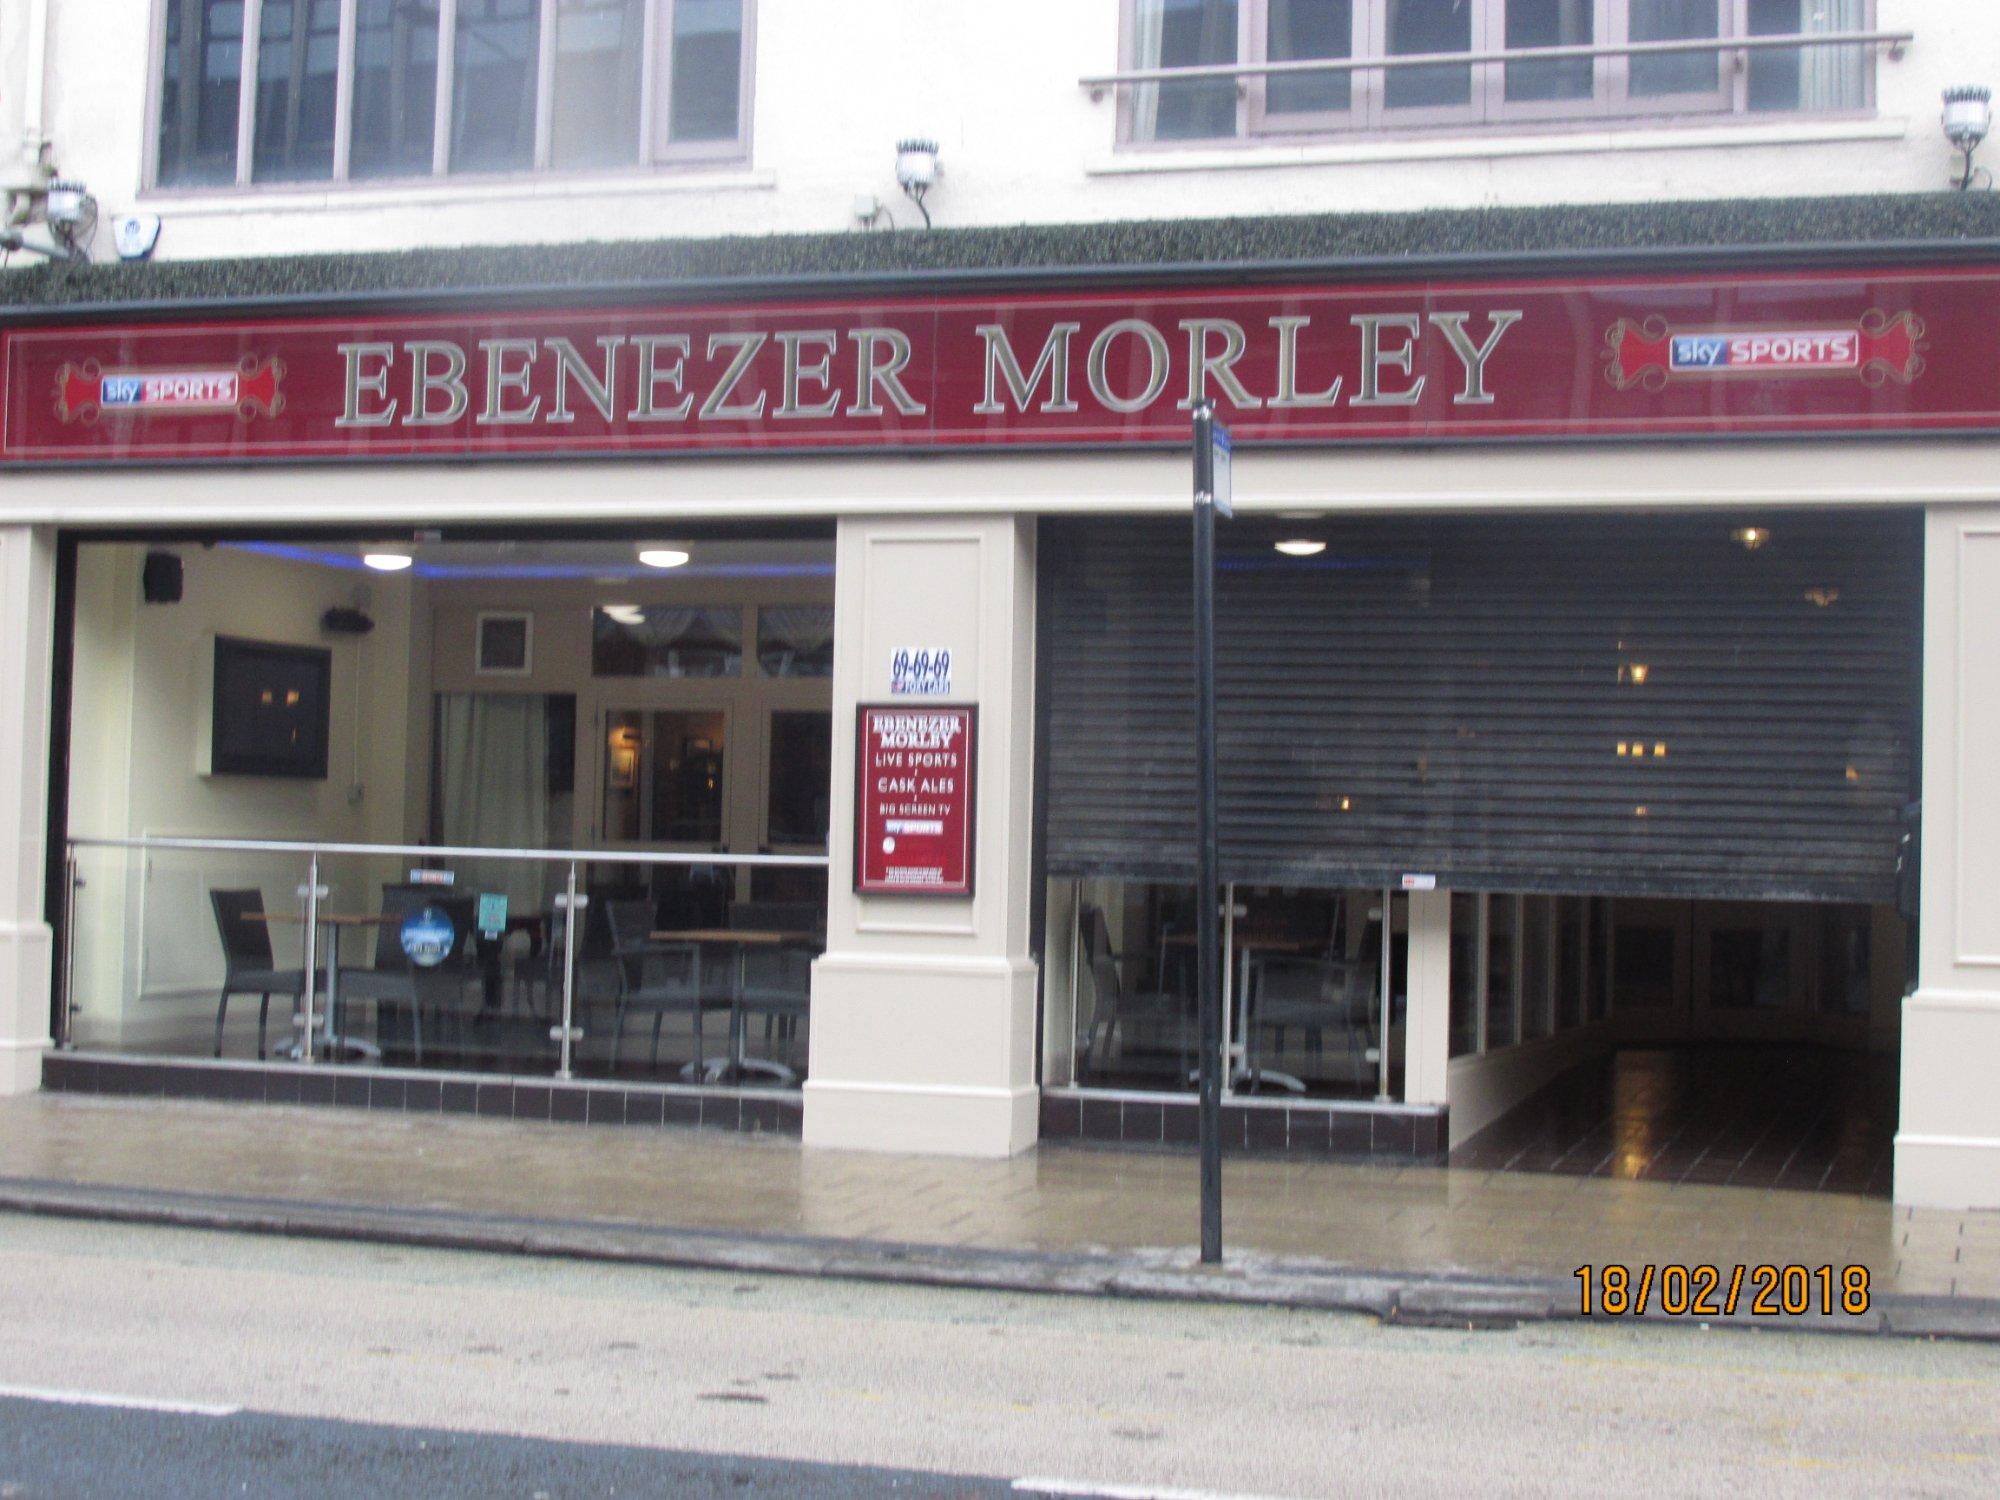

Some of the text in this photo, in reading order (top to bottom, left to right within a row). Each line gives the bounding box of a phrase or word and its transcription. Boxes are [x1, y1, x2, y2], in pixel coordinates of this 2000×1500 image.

[1677, 338, 1850, 366] sky SPORTS
[335, 310, 1523, 428] EBENEZER MORLEY
[106, 374, 234, 404] sky SPORTS
[893, 650, 950, 679] 69-69-69
[873, 714, 961, 734] EBENEZER
[880, 731, 954, 749] MORLEY
[875, 752, 957, 768] LIVE SPORTS
[878, 777, 954, 793] CASK ALES
